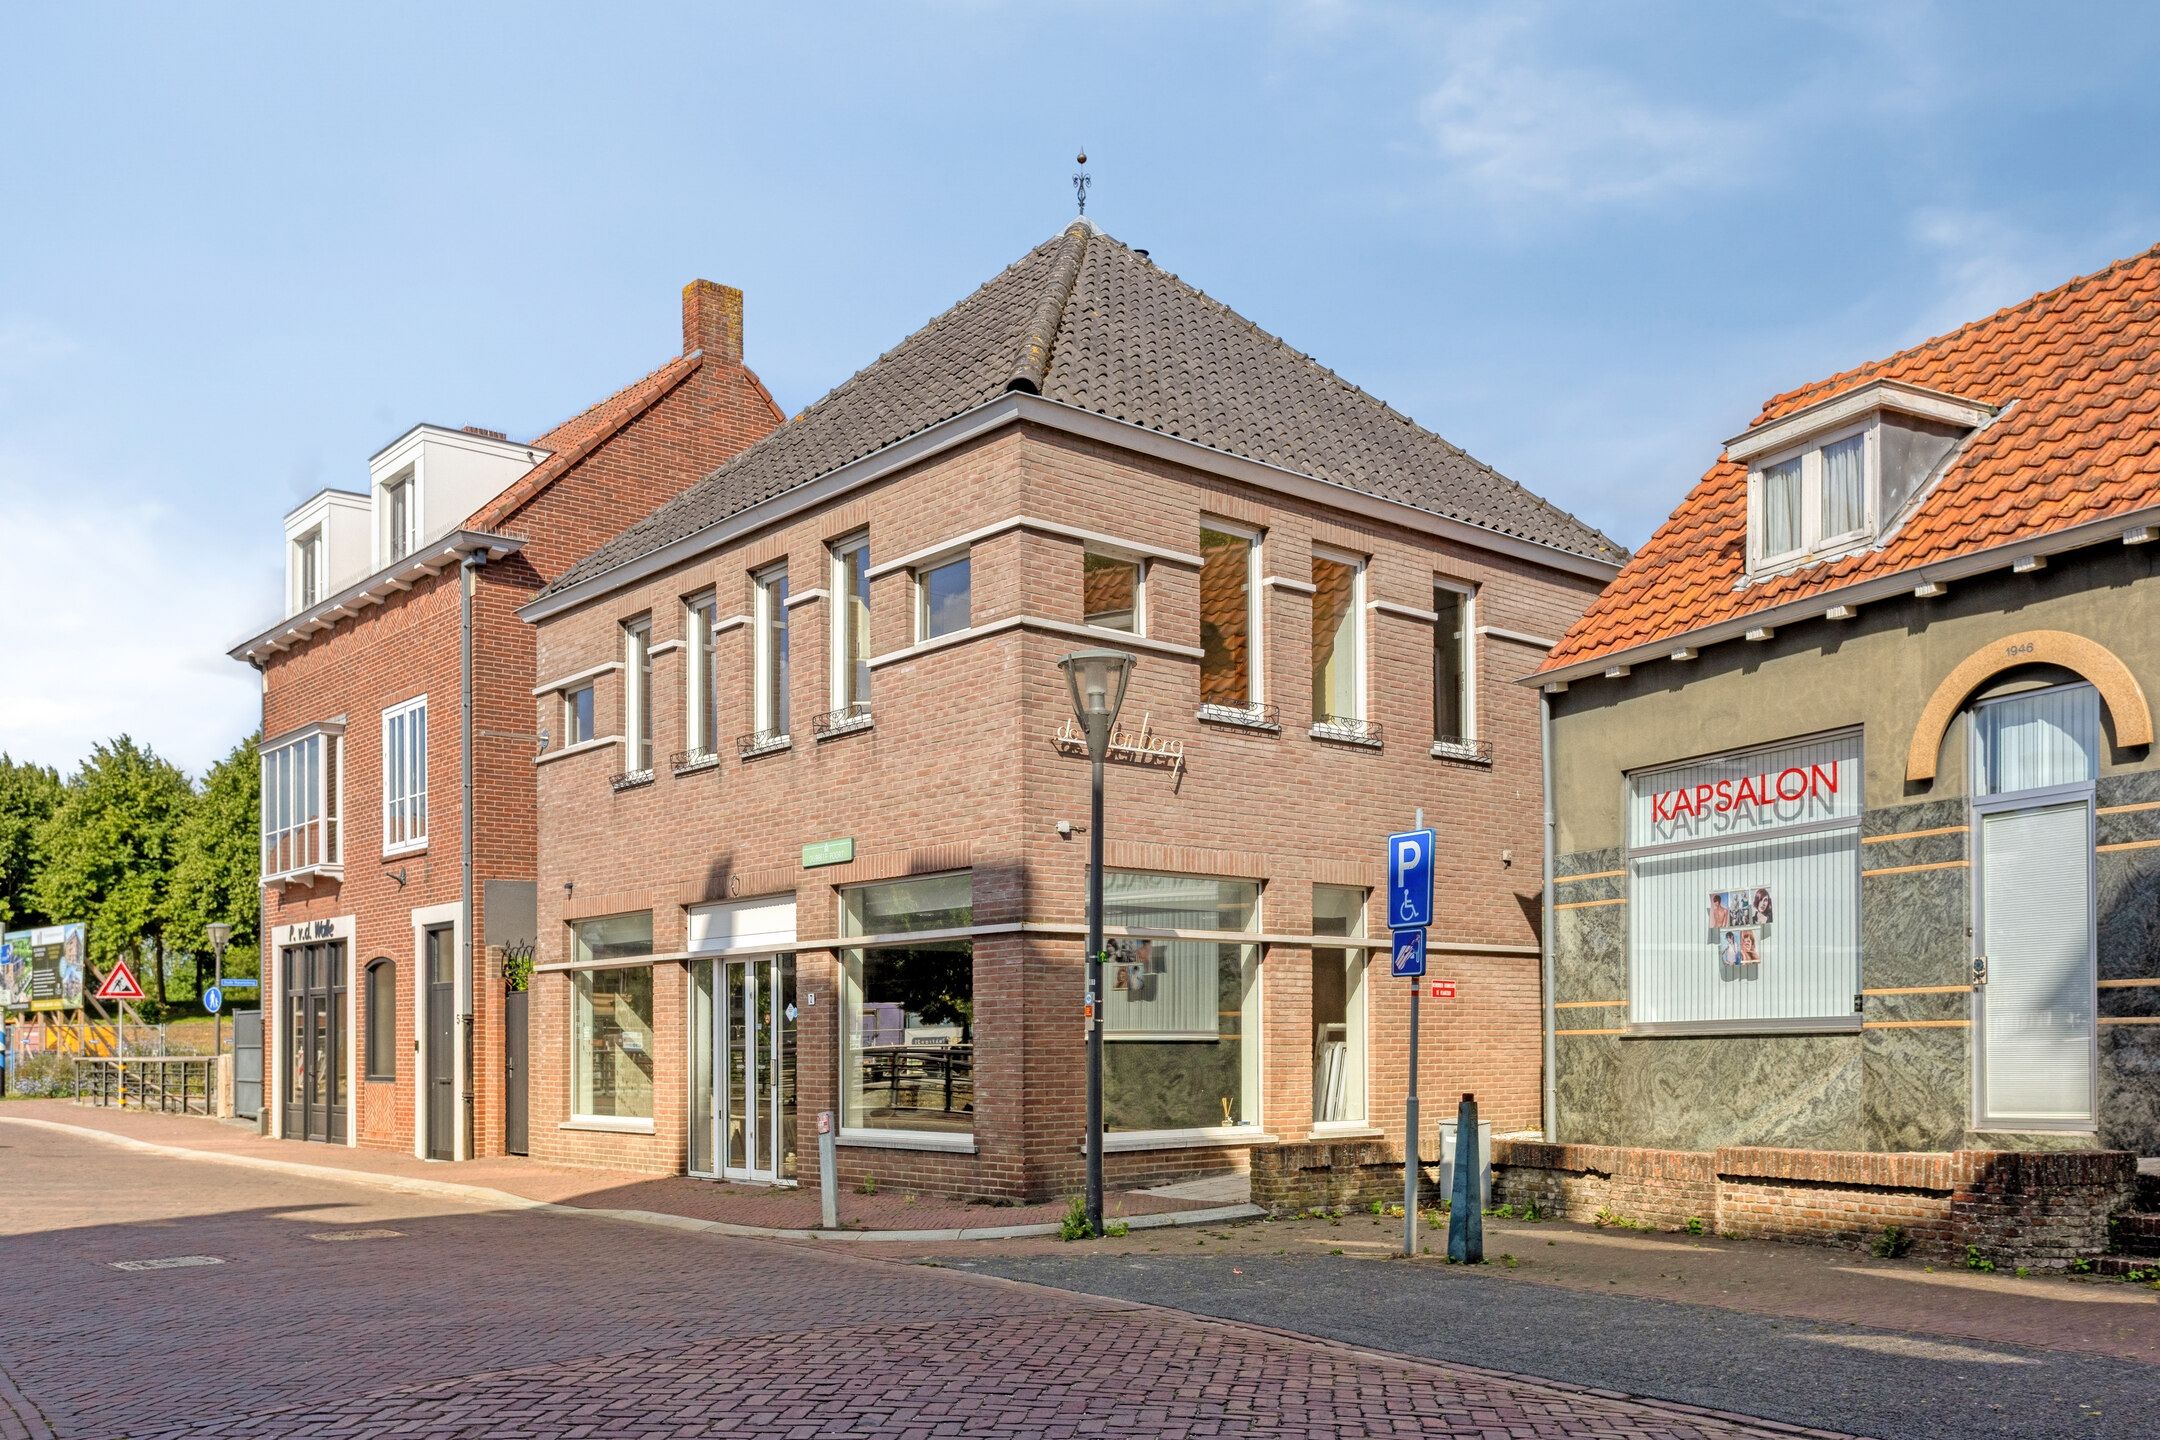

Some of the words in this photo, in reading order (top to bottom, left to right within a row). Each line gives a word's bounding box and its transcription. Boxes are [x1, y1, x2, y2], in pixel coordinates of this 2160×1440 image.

[2005, 642, 2034, 656] 1946
[1652, 760, 1838, 823] KAPSALON
[1398, 840, 1422, 888] P
